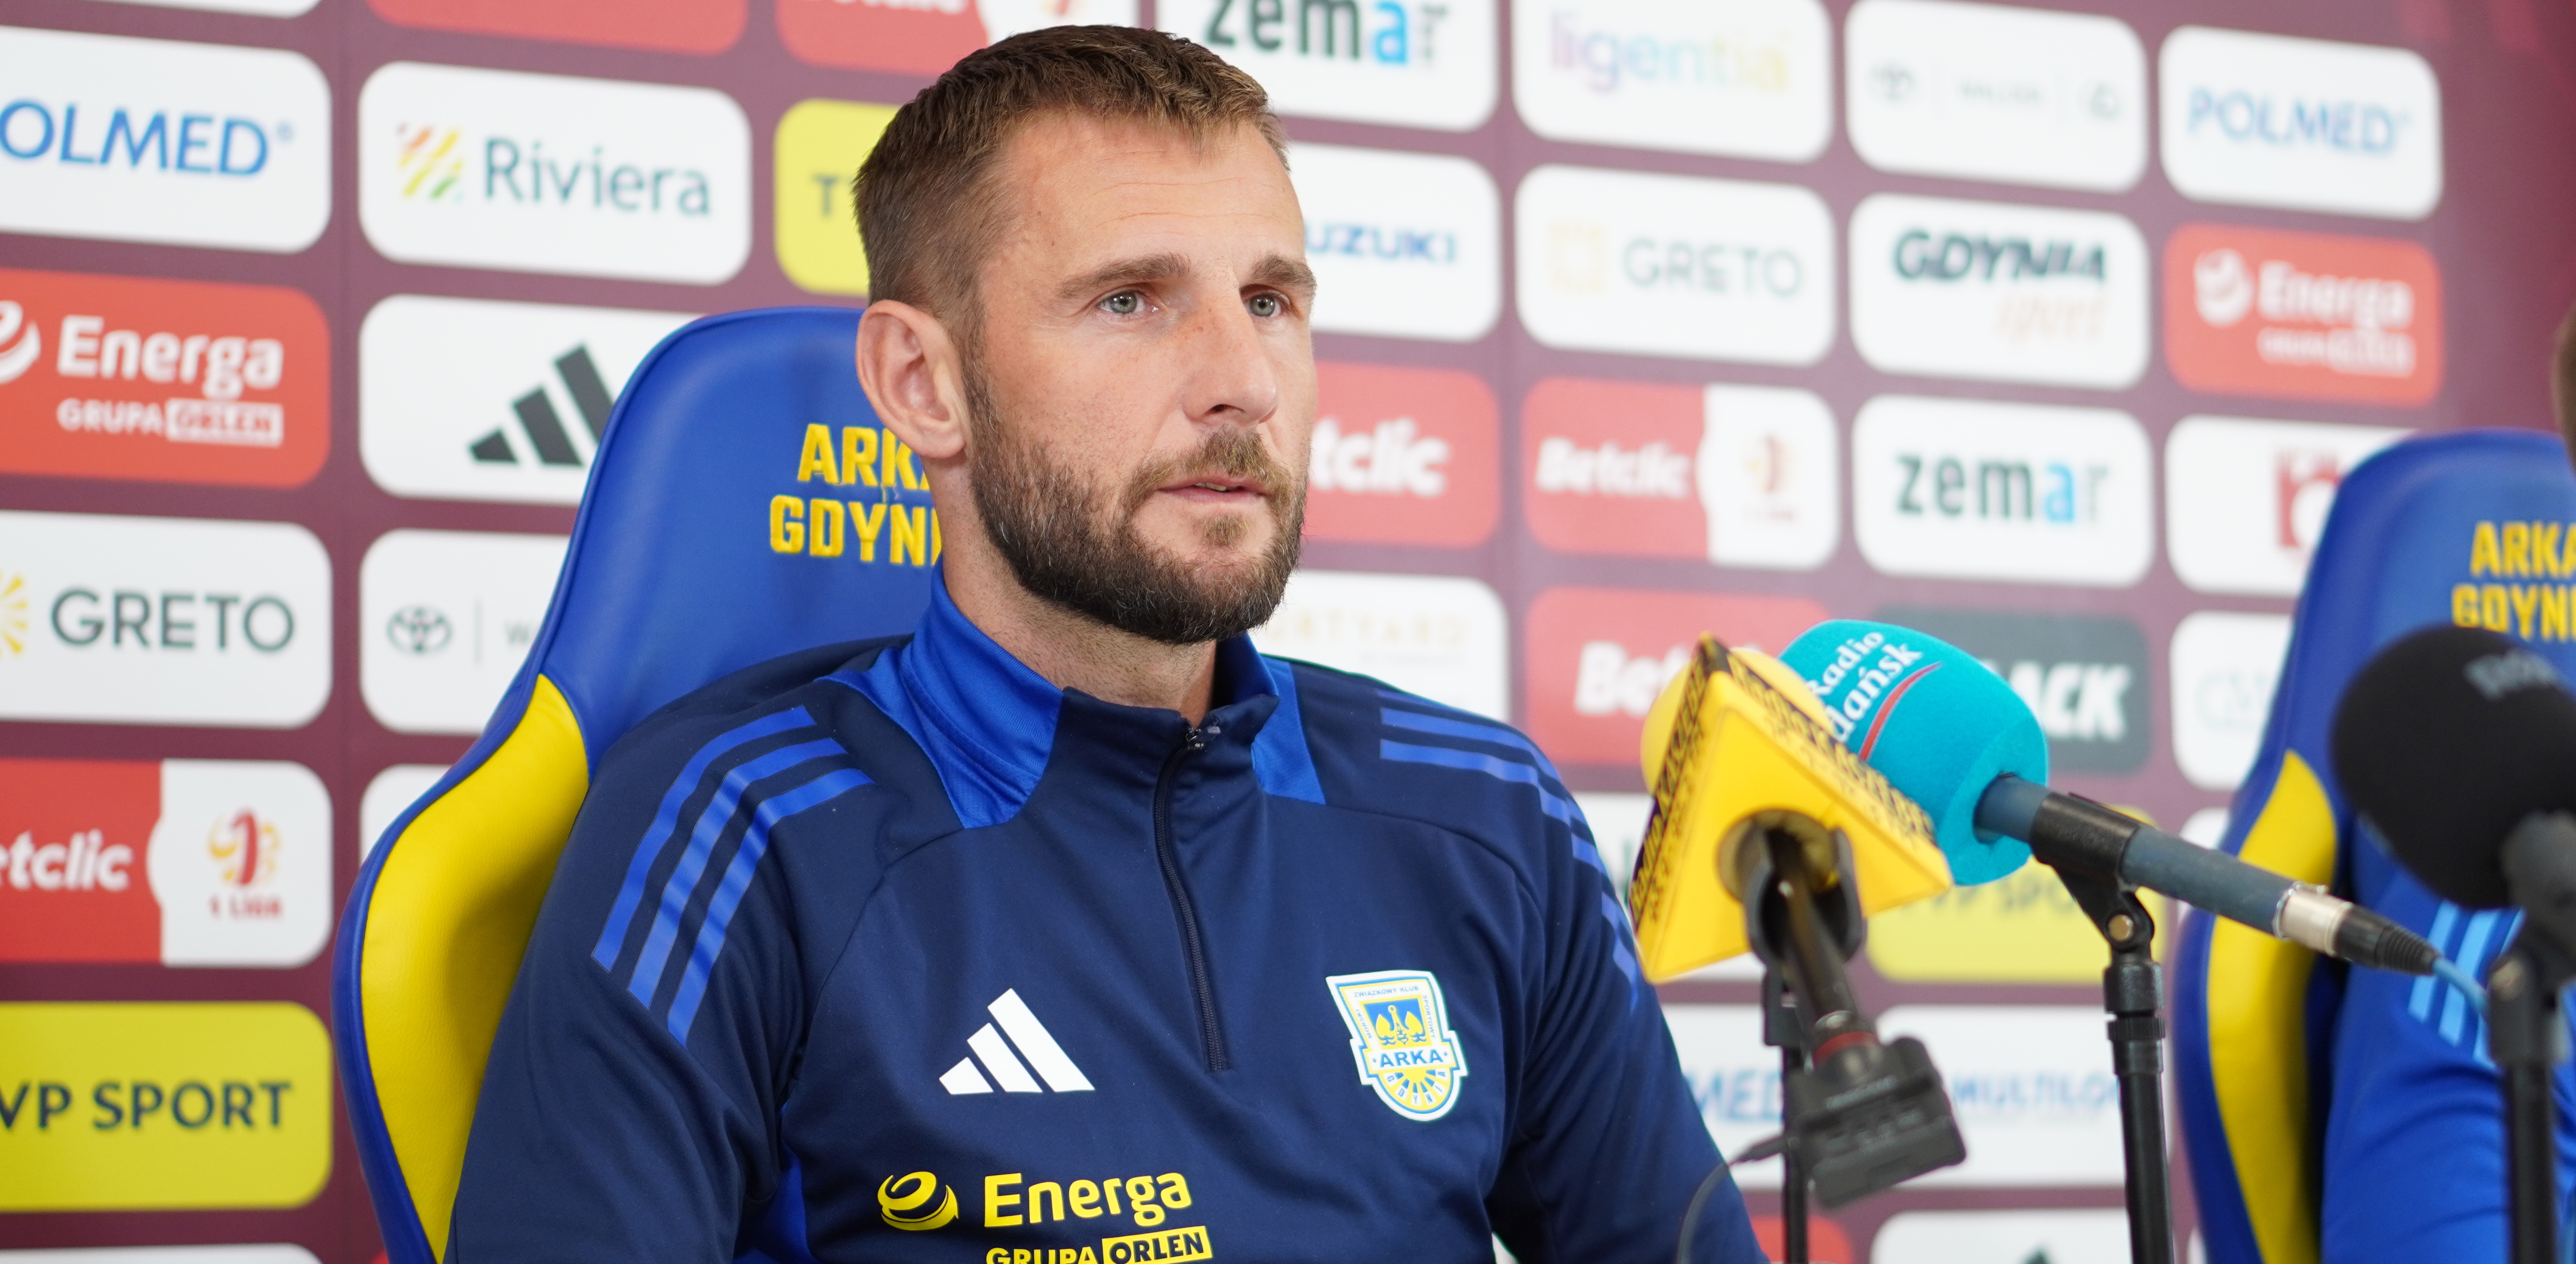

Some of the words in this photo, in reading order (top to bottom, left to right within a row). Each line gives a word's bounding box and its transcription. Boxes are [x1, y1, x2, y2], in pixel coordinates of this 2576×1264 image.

[1206, 0, 1449, 65] zemar
[0, 100, 269, 177] OLMED
[2187, 86, 2397, 154] POLMED
[484, 136, 711, 216] Riviera
[1622, 238, 1804, 298] GRETO
[1891, 227, 2106, 283] GDYNIA
[2258, 261, 2415, 332] Energa
[57, 314, 284, 400] Energa
[57, 398, 163, 435] GRUPA
[797, 423, 929, 490] ARK
[1535, 437, 1690, 500] Betclic
[1895, 453, 2110, 524] zemar
[50, 588, 295, 652] GRETO
[1984, 659, 2132, 741] ACK
[1355, 1009, 1373, 1039] MORSKI
[1423, 995, 1436, 1039] SPORTOWY
[1380, 1049, 1444, 1068] ARKA
[93, 1081, 292, 1131] SPORT
[984, 1173, 1191, 1227] Energa
[986, 1246, 1097, 1264] GRUPA
[1109, 1232, 1203, 1263] ORLEN
